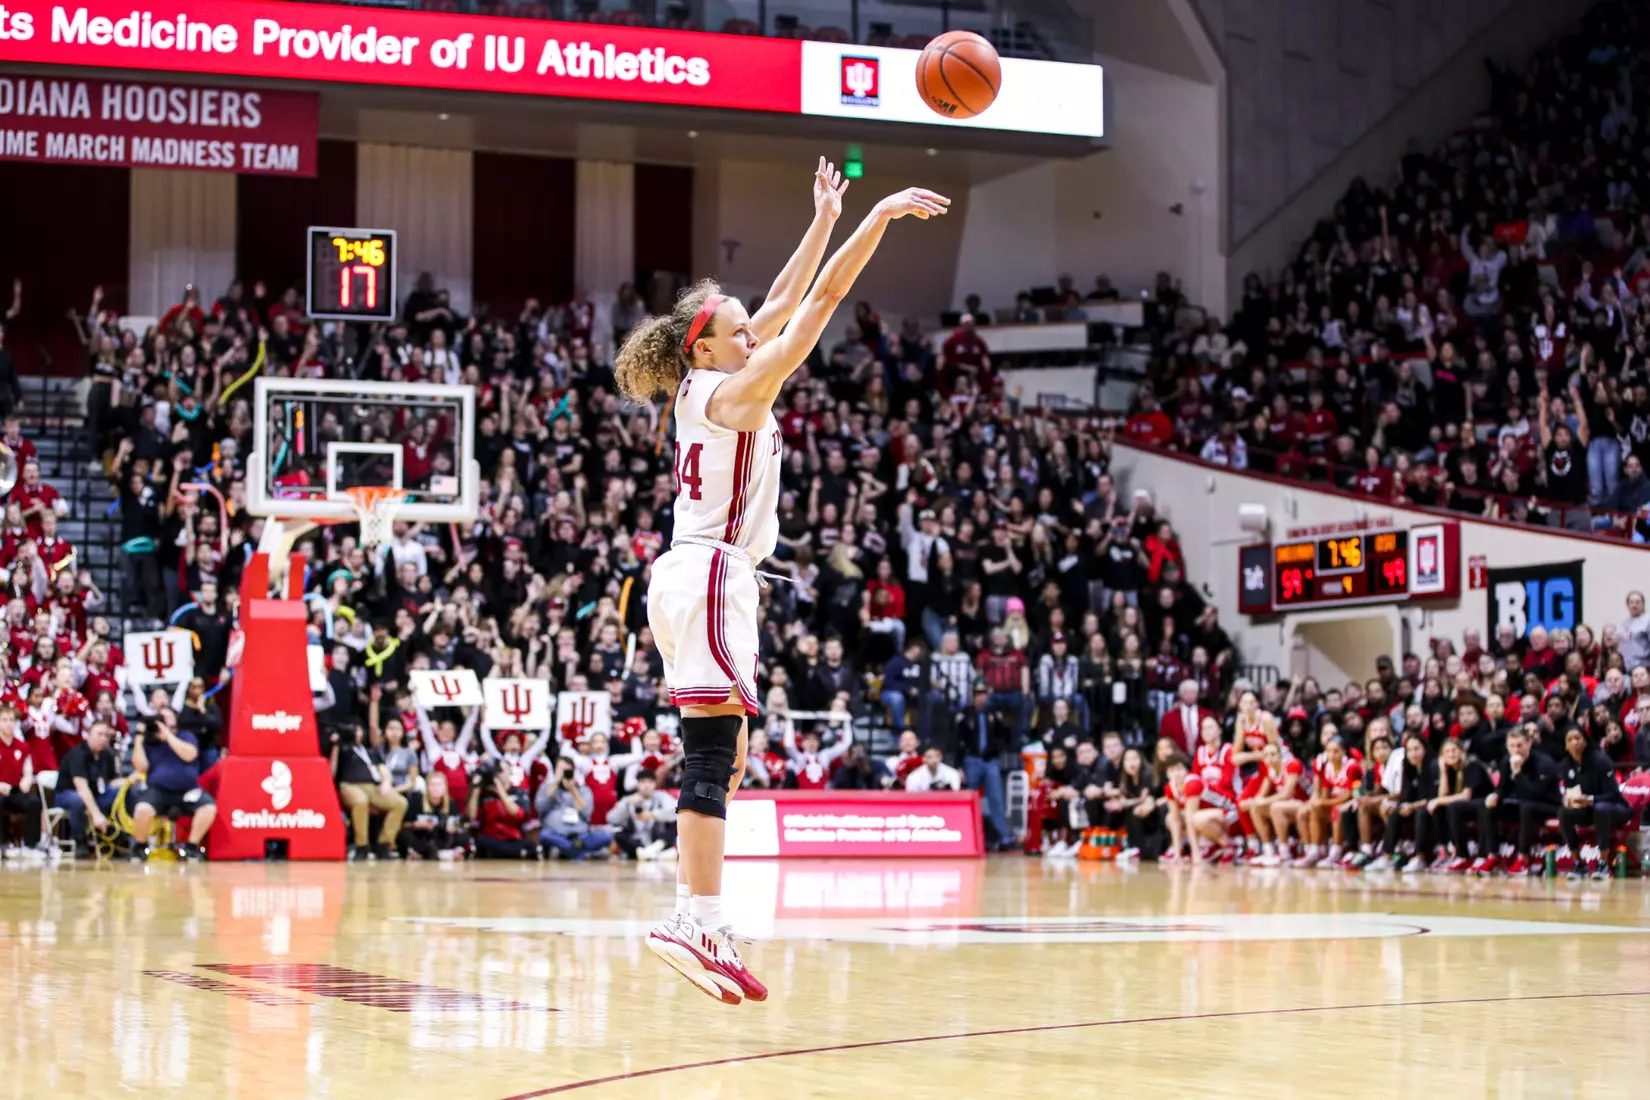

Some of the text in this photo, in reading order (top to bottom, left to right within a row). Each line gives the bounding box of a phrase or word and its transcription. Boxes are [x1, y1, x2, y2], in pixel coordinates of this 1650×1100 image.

[51, 6, 238, 53] Medicine
[253, 19, 419, 65] Provider
[430, 33, 474, 69] of
[484, 35, 525, 72] IU
[537, 39, 711, 86] Athletics
[0, 78, 262, 128] DIANA HOOSIERS
[46, 132, 125, 162] MARCH
[131, 136, 235, 168] MADNESS
[241, 142, 299, 171] TEAM
[333, 237, 385, 266] 7:46
[340, 265, 376, 308] 17
